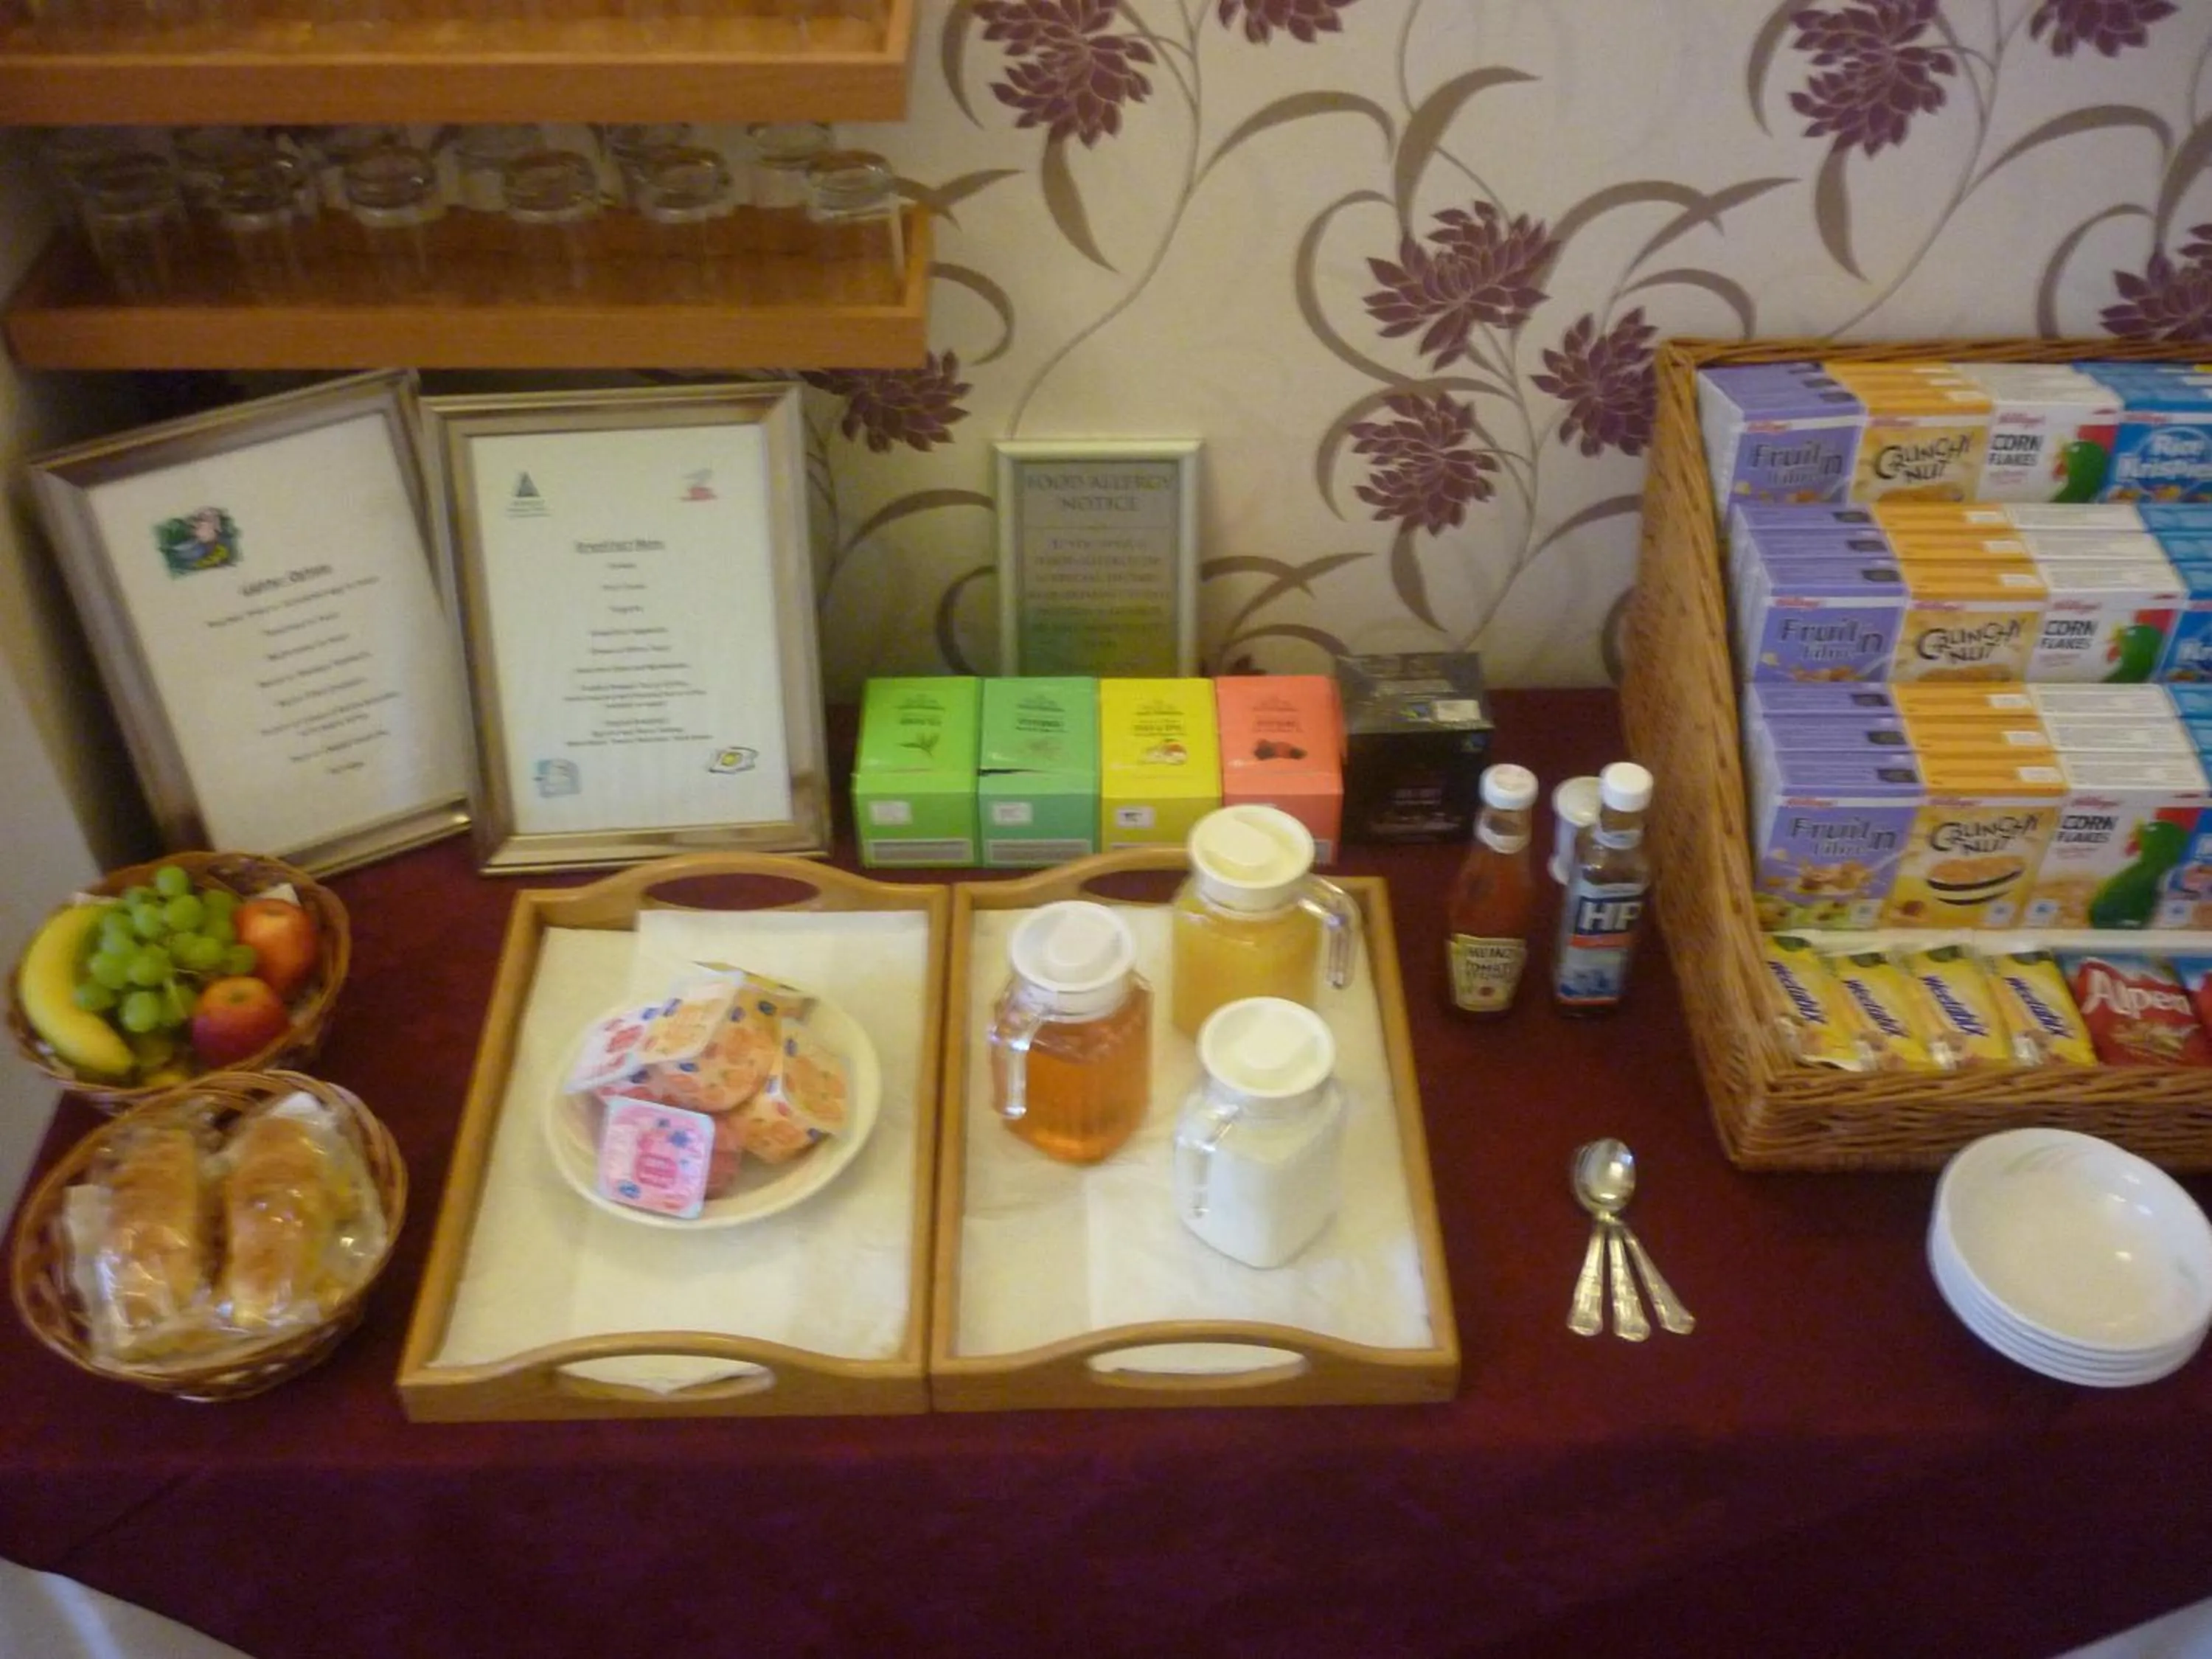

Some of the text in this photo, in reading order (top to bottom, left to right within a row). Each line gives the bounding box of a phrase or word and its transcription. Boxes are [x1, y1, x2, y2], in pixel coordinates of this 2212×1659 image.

[1992, 434, 2044, 451] CORN
[1988, 452, 2039, 467] FLAKES
[2044, 620, 2099, 636] CORN
[2040, 638, 2094, 650] FLAKES
[2062, 815, 2119, 830] CORN
[2056, 831, 2111, 844] FLAKES
[1579, 900, 1643, 932] HP
[2081, 967, 2194, 1020] Alpen
